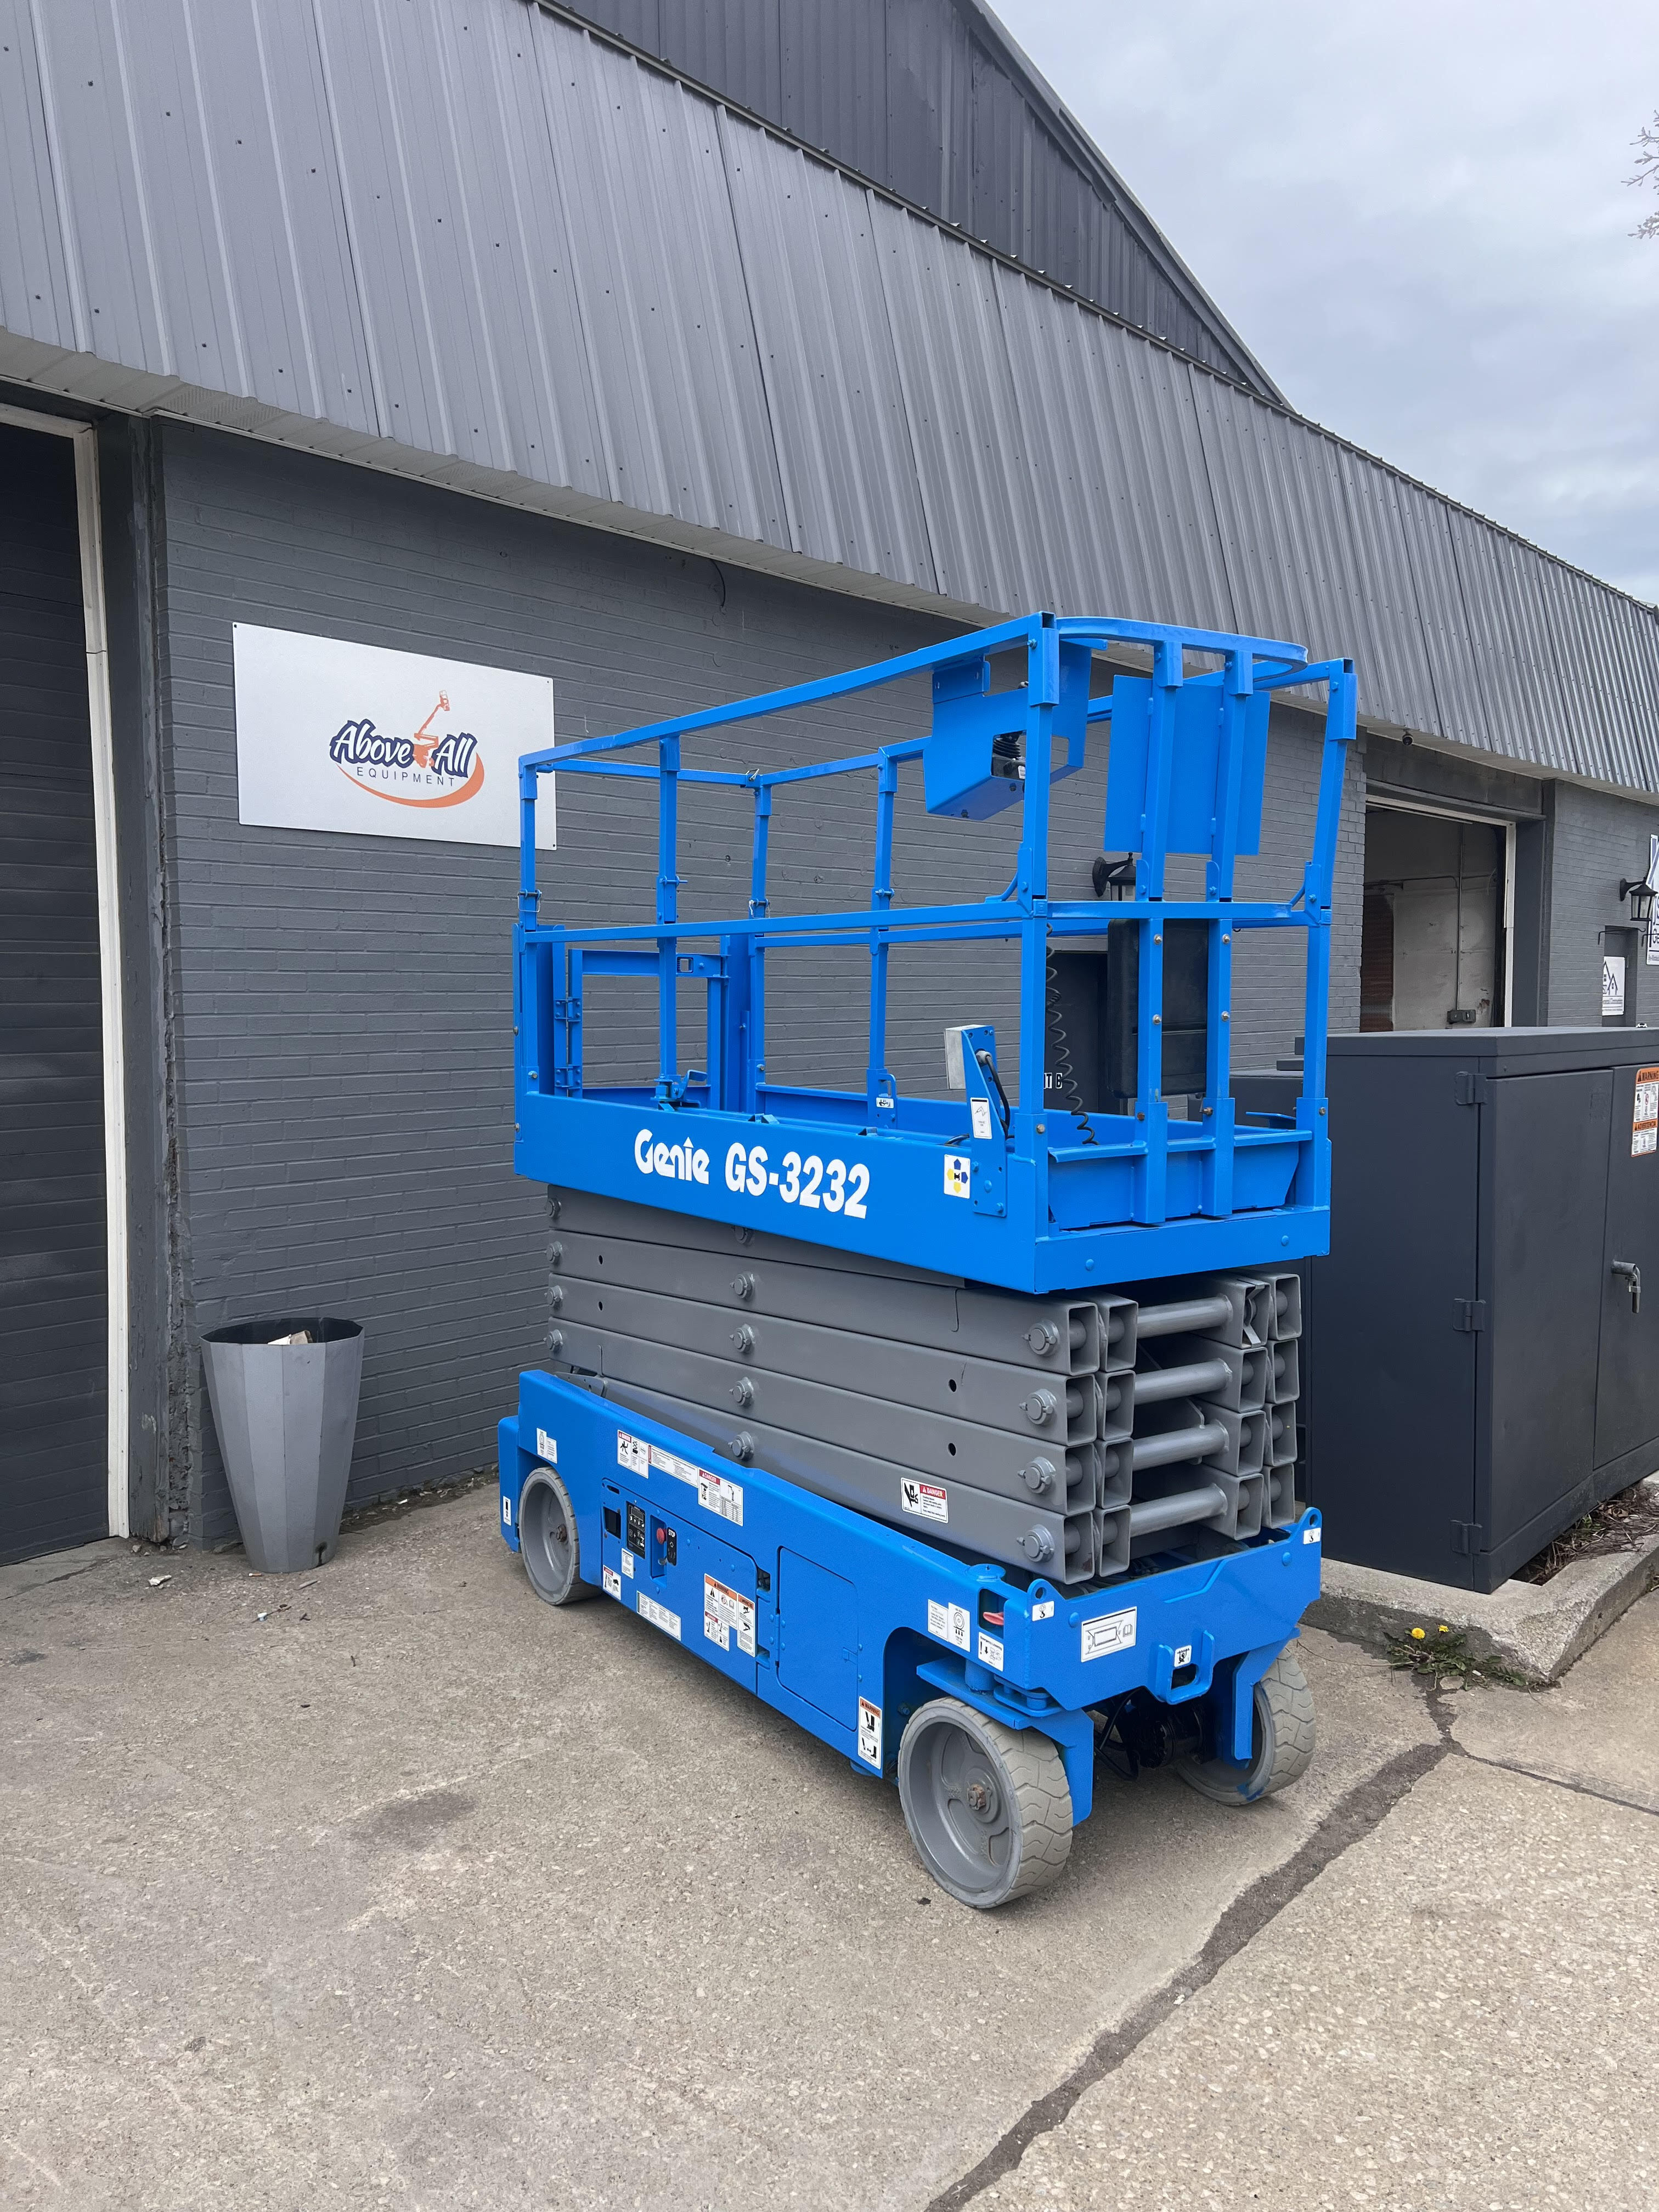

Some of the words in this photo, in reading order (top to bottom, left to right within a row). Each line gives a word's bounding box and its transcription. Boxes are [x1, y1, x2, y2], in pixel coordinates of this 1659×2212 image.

[331, 720, 413, 766] Above
[432, 734, 477, 776] All
[357, 766, 455, 787] EQUIPMENT
[1056, 1073, 1063, 1088] B
[634, 1128, 709, 1184] Genie
[725, 1142, 870, 1219] GS-3232
[927, 1487, 944, 1498] DANGER
